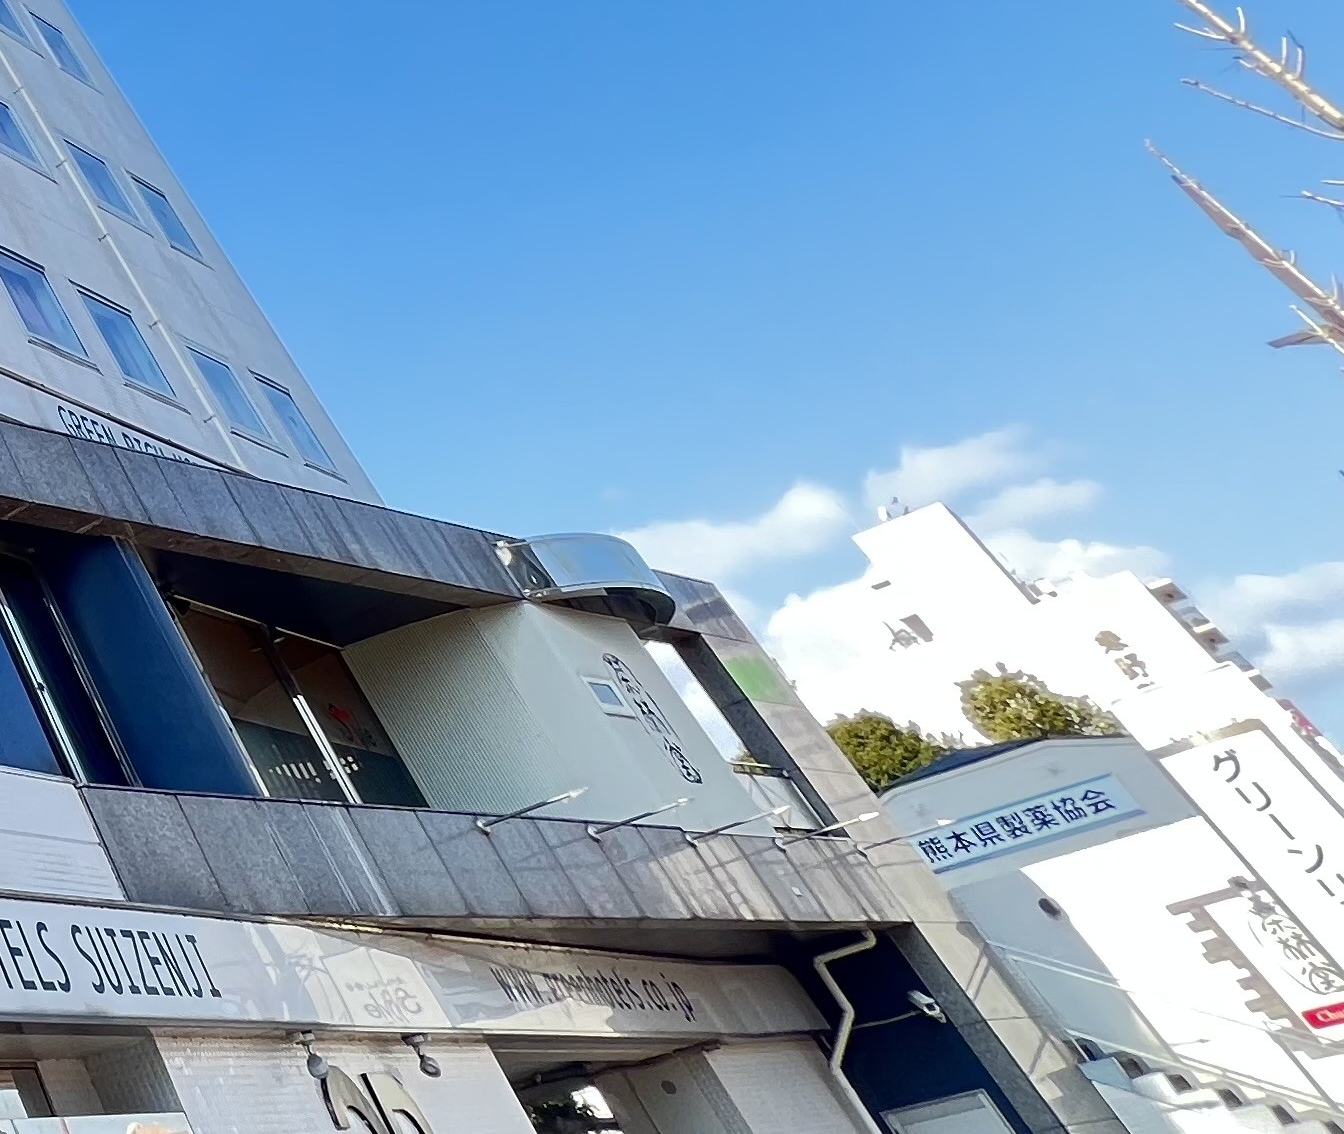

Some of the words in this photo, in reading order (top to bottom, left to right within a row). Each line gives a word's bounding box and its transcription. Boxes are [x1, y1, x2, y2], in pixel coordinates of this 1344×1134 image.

[918, 789, 1116, 863] 熊本県製薬協会
[69, 923, 223, 1000] SUIZENJI
